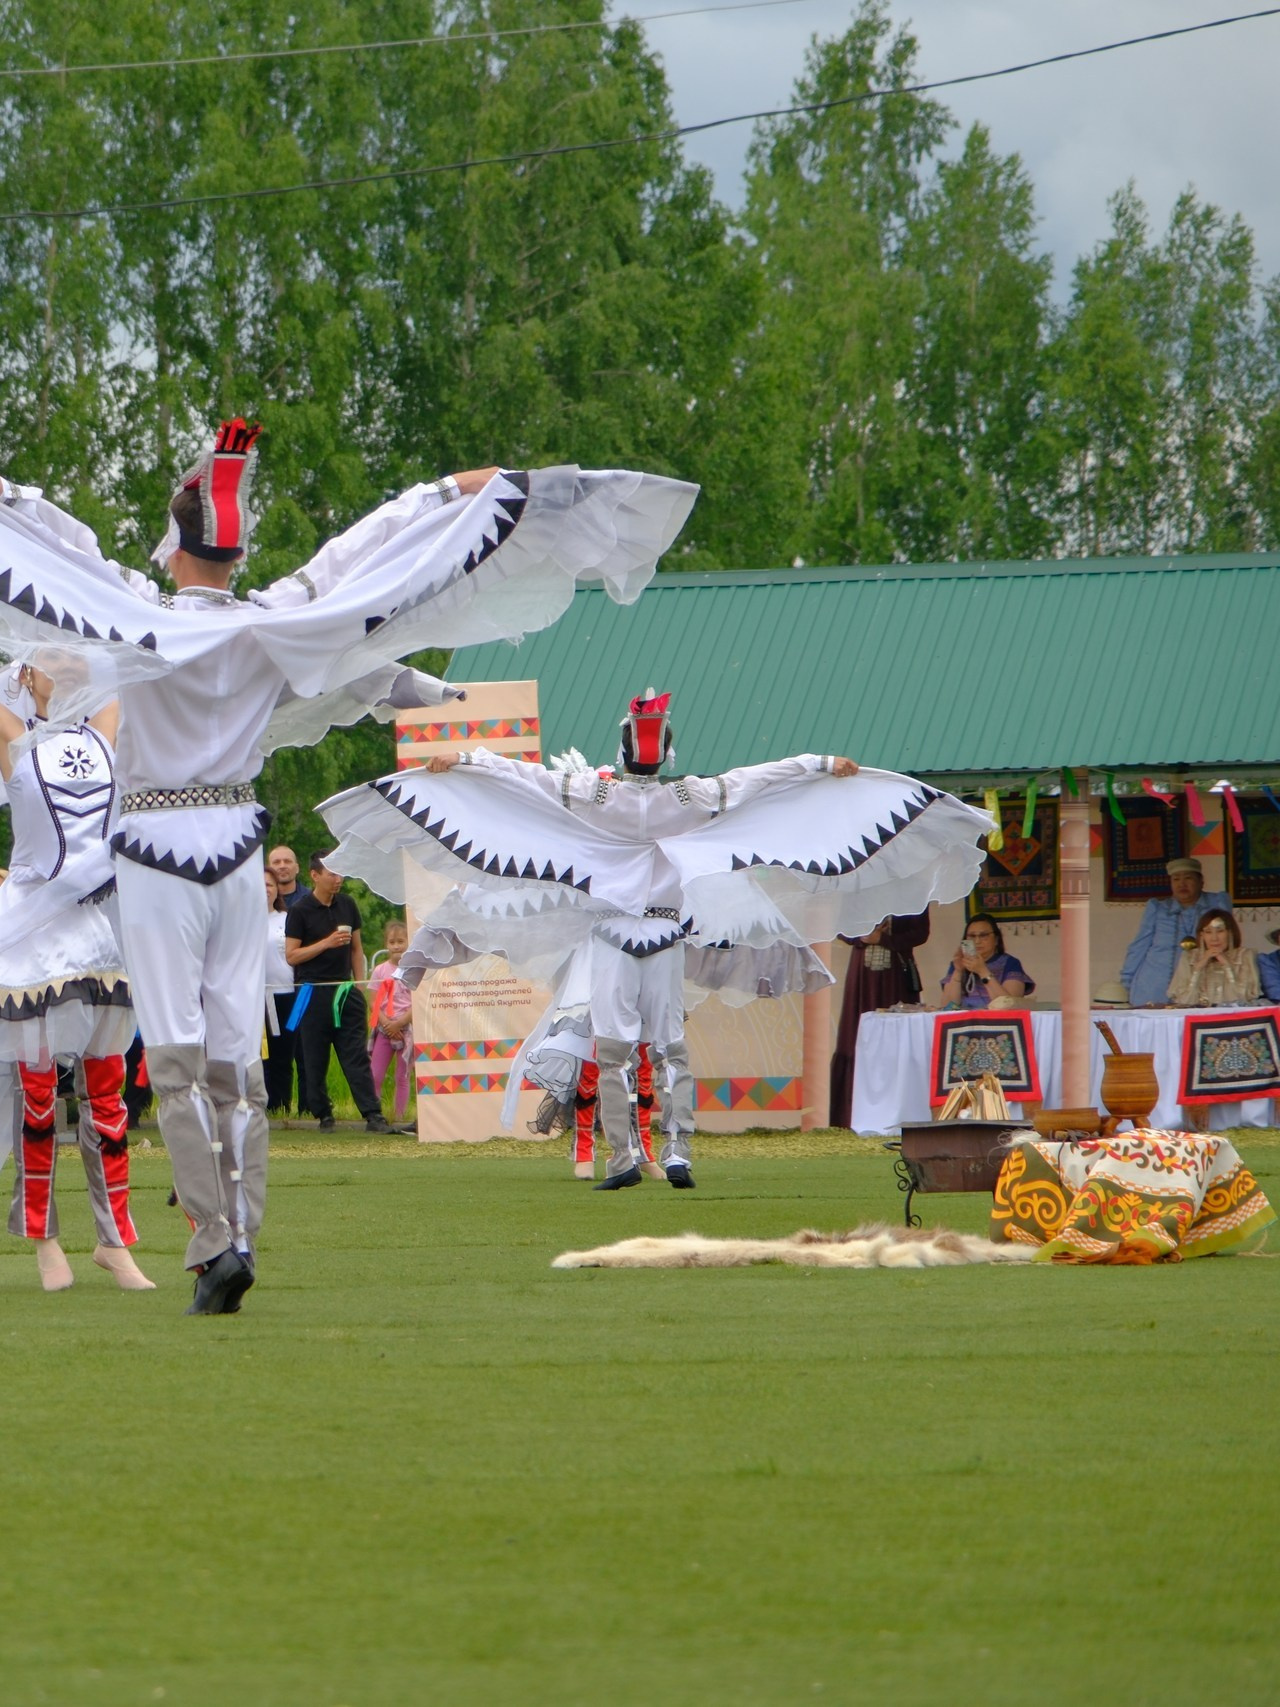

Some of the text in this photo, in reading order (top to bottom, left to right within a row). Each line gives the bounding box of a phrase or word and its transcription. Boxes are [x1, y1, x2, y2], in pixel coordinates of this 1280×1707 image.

[442, 978, 517, 987] ярмарка-продажа
[429, 987, 532, 998] товаропроизводителей
[438, 1000, 496, 1009] предприятий
[497, 998, 531, 1007] Якутии
